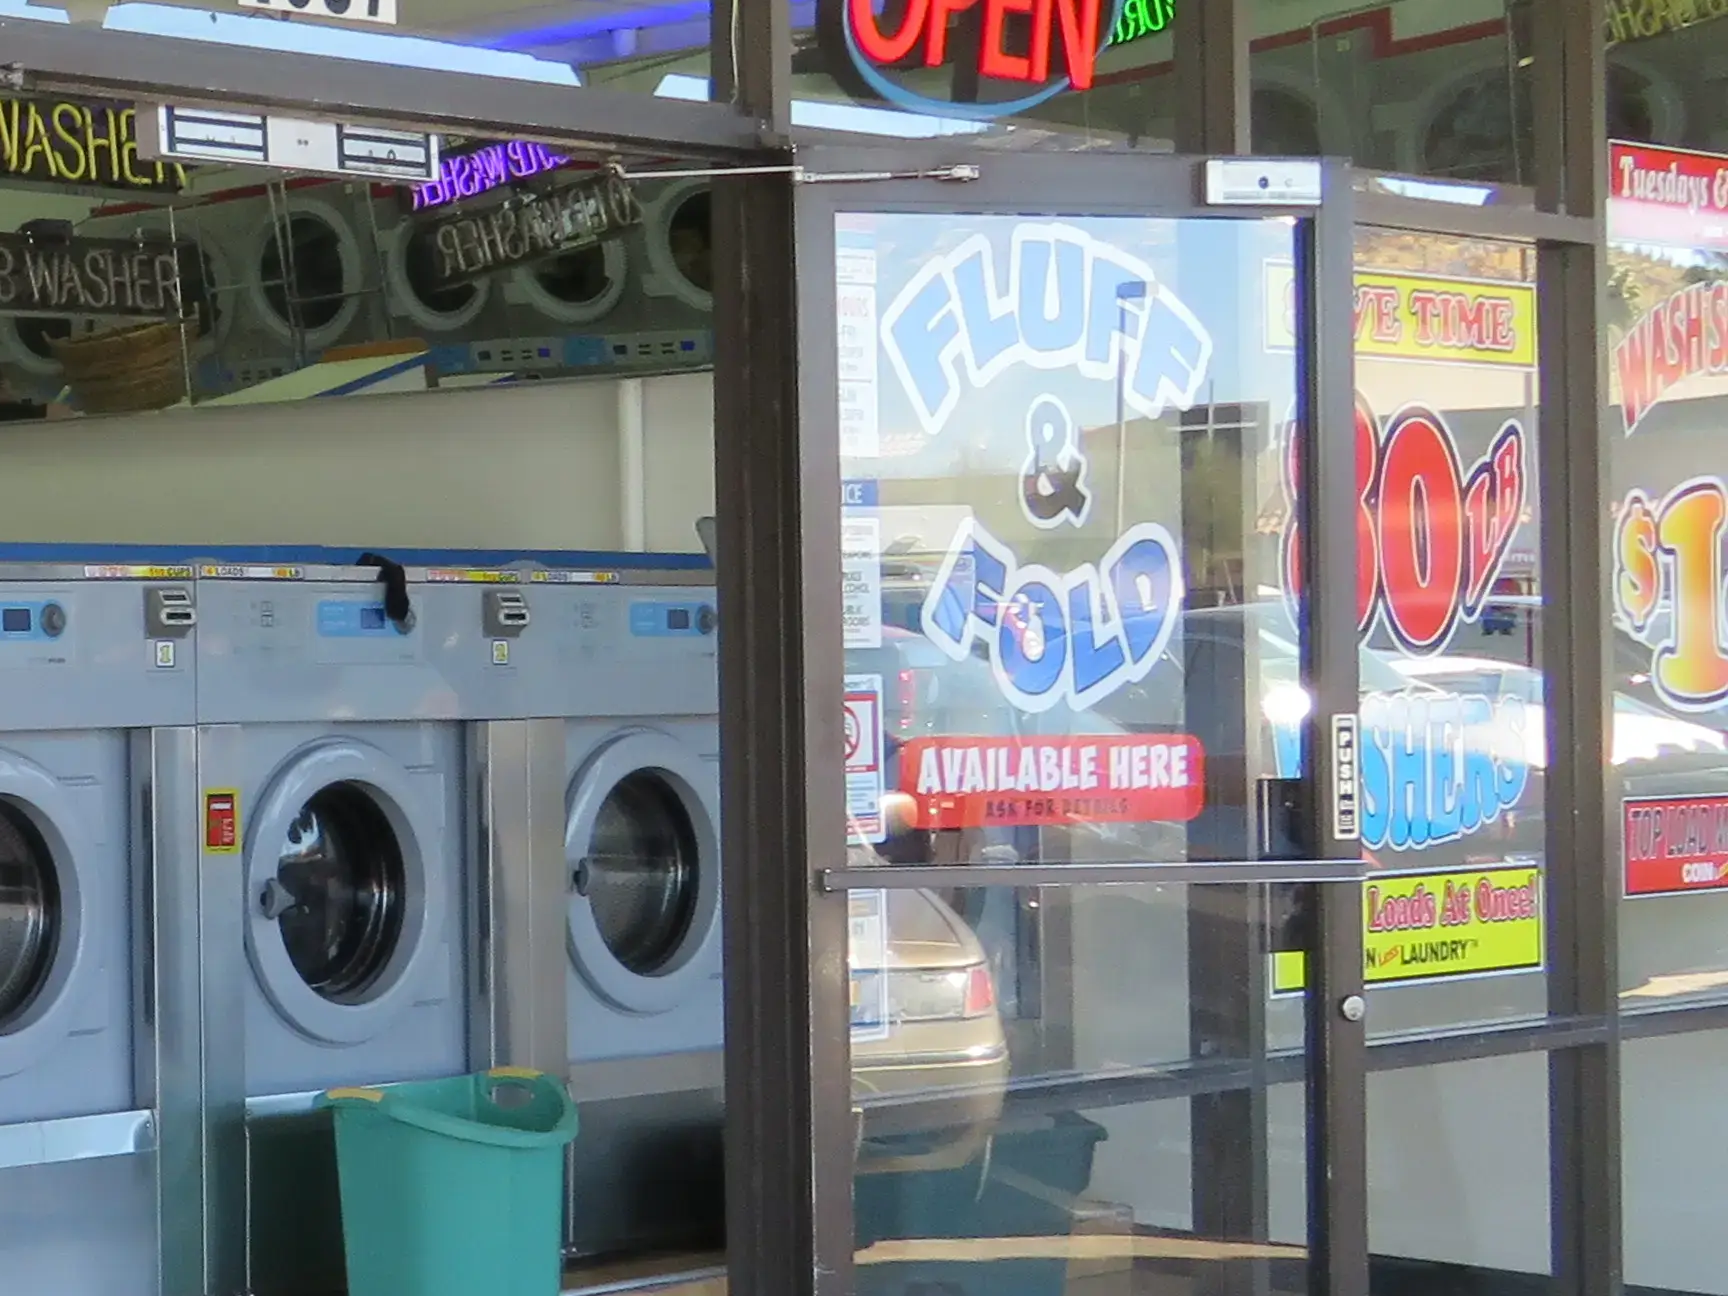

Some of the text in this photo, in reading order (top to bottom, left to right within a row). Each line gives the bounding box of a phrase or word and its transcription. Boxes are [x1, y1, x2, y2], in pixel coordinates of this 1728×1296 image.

[1619, 156, 1709, 215] Tuesdays
[25, 249, 179, 309] WASHER
[882, 223, 1212, 435] FLUFF
[1410, 288, 1516, 351] TIME
[1018, 392, 1092, 530] &
[921, 516, 1183, 714] FOLD
[160, 645, 171, 663] 1
[916, 744, 1190, 795] AVAILABLE HERE
[1338, 730, 1353, 797] PUSH
[986, 800, 1017, 818] ASK
[1025, 800, 1055, 817] FOR
[1628, 807, 1664, 861] TOP
[1665, 805, 1711, 859] LOAD
[1367, 873, 1537, 933] Loads At Once!
[1400, 938, 1468, 966] LAUNDRY
